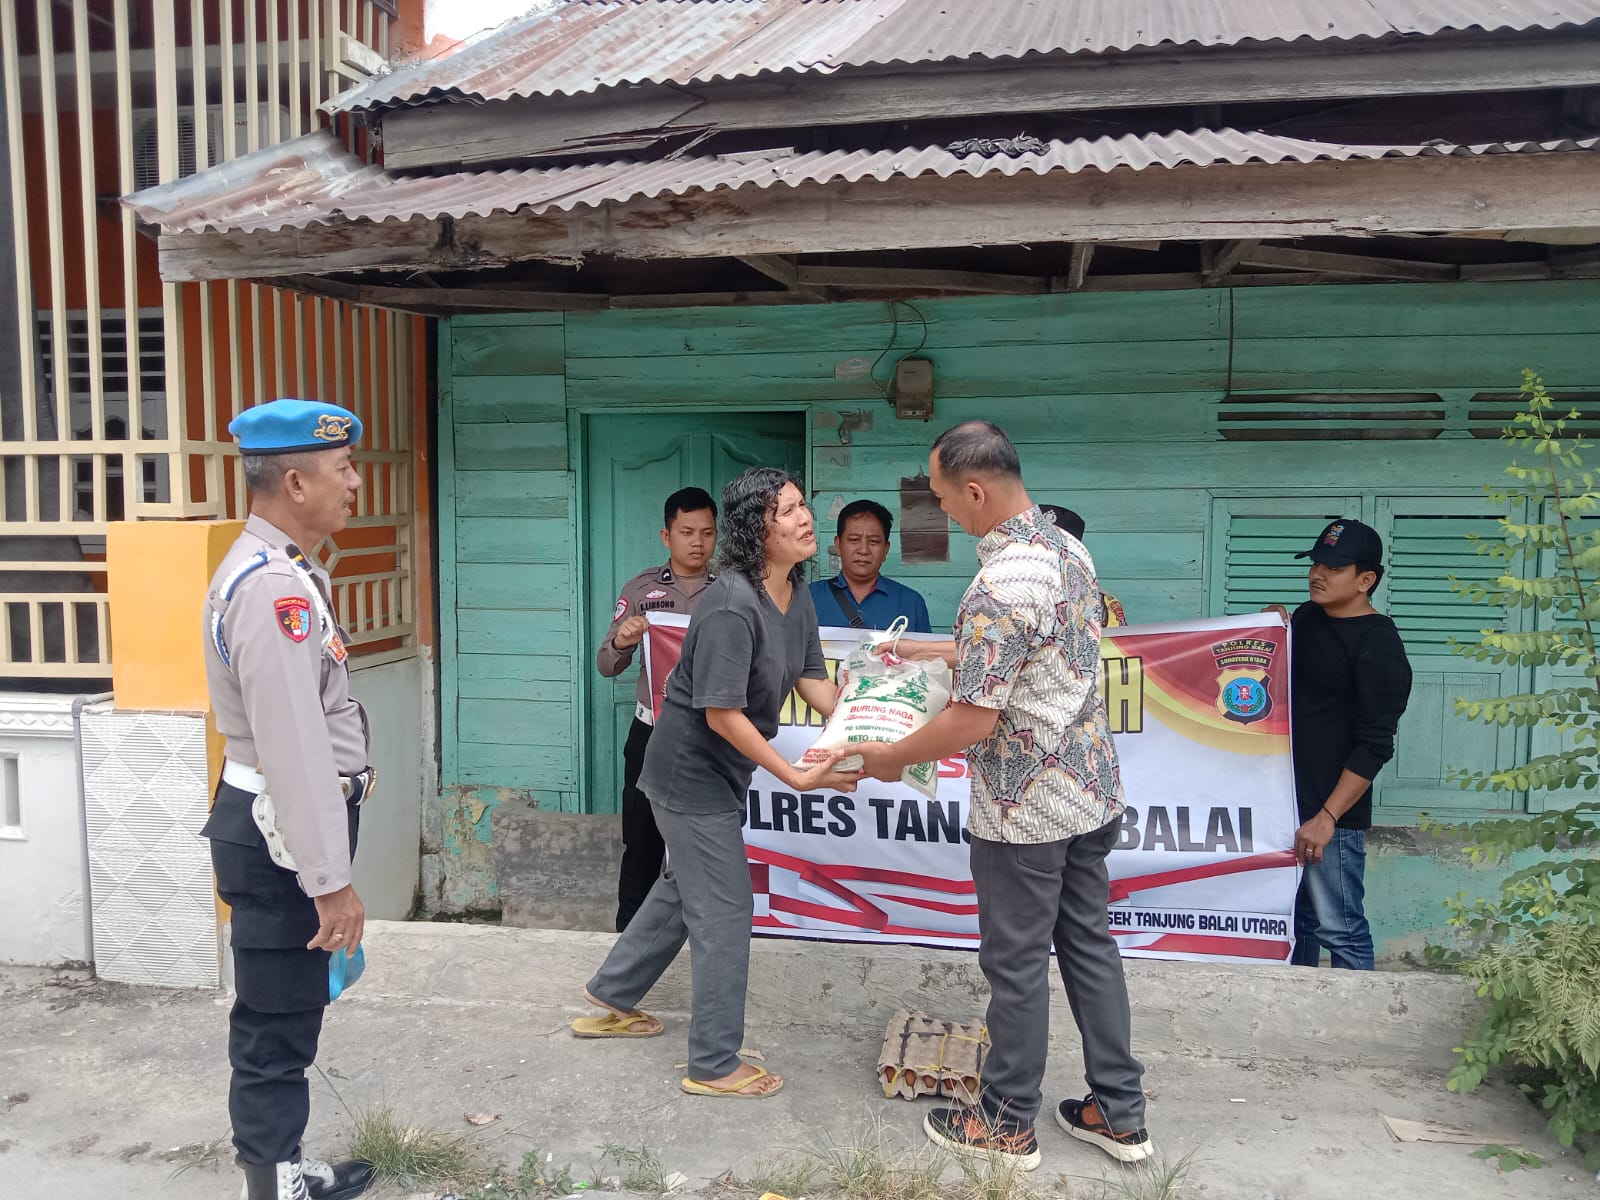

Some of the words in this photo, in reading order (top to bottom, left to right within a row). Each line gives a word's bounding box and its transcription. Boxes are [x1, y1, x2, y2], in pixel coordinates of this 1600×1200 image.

[1222, 640, 1267, 648] POLRES
[850, 705, 887, 714] BURUNG
[888, 708, 914, 721] NAGA
[848, 734, 869, 742] NETO
[741, 789, 857, 838] LRES
[868, 798, 971, 845] TAN
[1111, 805, 1254, 853] BALAI
[1134, 912, 1195, 930] TANJUNG
[1198, 914, 1238, 932] BALAI
[1241, 917, 1287, 936] UTARA
